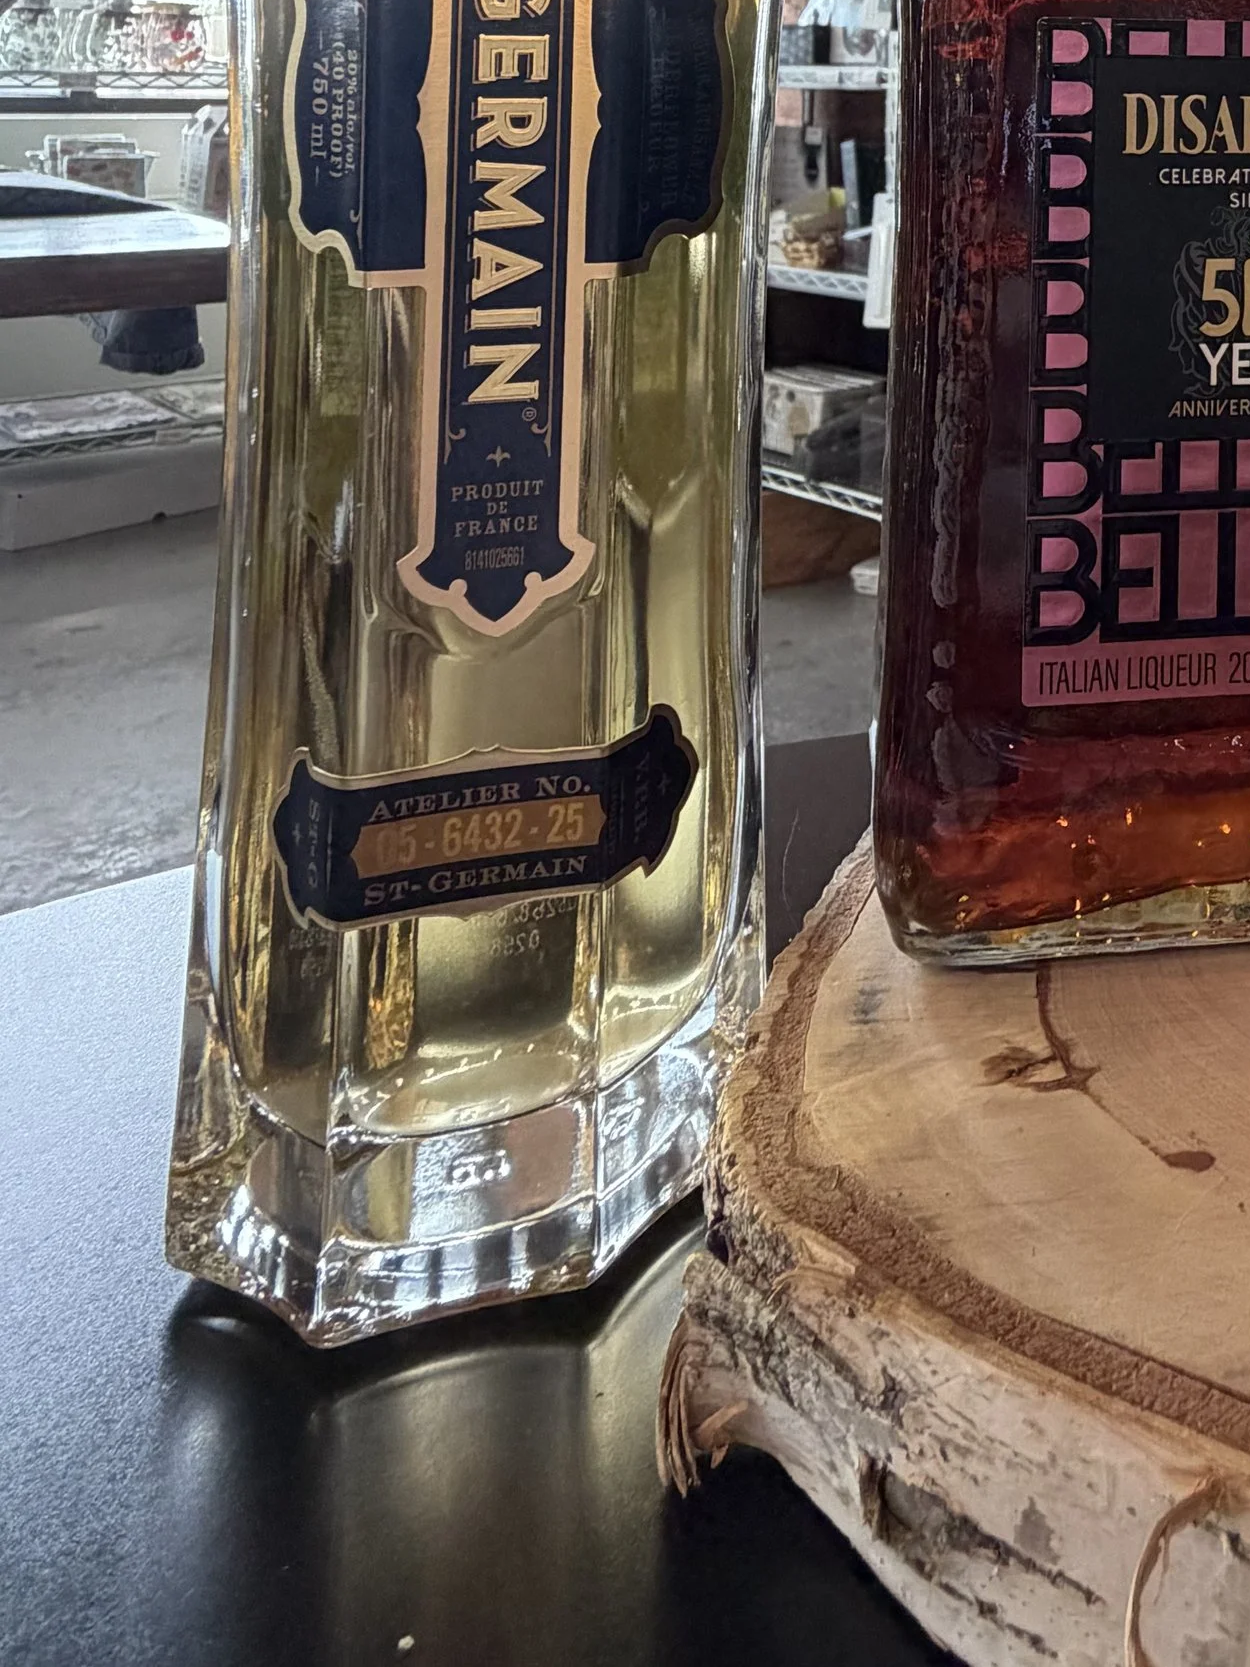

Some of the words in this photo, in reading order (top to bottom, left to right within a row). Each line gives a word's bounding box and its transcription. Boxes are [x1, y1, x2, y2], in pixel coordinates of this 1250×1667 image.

[330, 41, 346, 81] (40
[345, 48, 358, 95] 20%
[311, 57, 329, 116] 750
[309, 122, 328, 160] ml
[327, 88, 345, 179] PROOF)
[451, 480, 544, 502] PRODUIT
[486, 501, 508, 516] DE
[454, 515, 539, 538] FRANCE
[1039, 656, 1120, 695] ITALIAN
[1126, 651, 1217, 691] LIQUEUR
[368, 782, 521, 823] ATELIER
[535, 773, 592, 798] NO.
[362, 854, 588, 907] ST-GERMAIN
